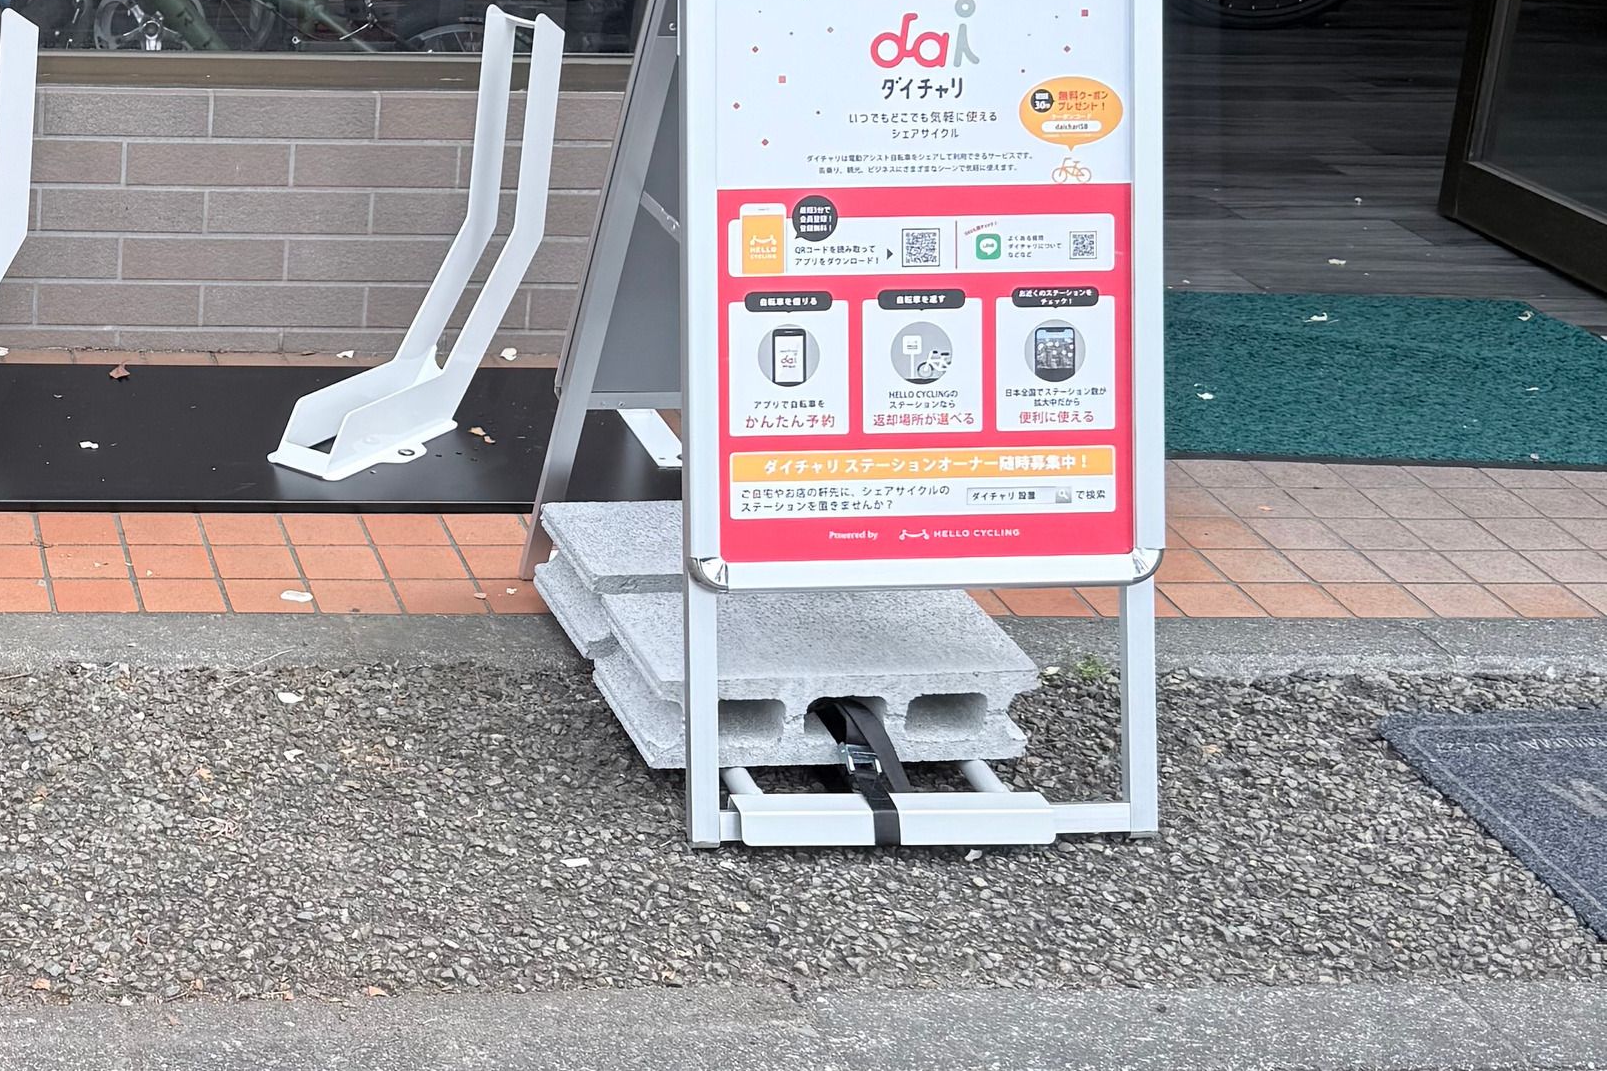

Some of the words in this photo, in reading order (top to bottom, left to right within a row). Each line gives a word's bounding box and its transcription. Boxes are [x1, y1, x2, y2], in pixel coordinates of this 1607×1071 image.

[881, 76, 964, 100] ダイチャリ
[849, 110, 998, 124] いつでもどこでも気軽に使える
[892, 127, 960, 140] シェアサイクル
[753, 400, 825, 409] アプリで自転車を
[889, 400, 956, 409] ステーションなら
[745, 414, 835, 429] かんたん予約
[873, 412, 975, 428] 返却場所が選べる
[1019, 410, 1094, 425] 便利に使える
[828, 530, 866, 539] Powered
[867, 531, 879, 540] by
[934, 529, 970, 538] HELLO
[973, 528, 1020, 537] CYCLING
